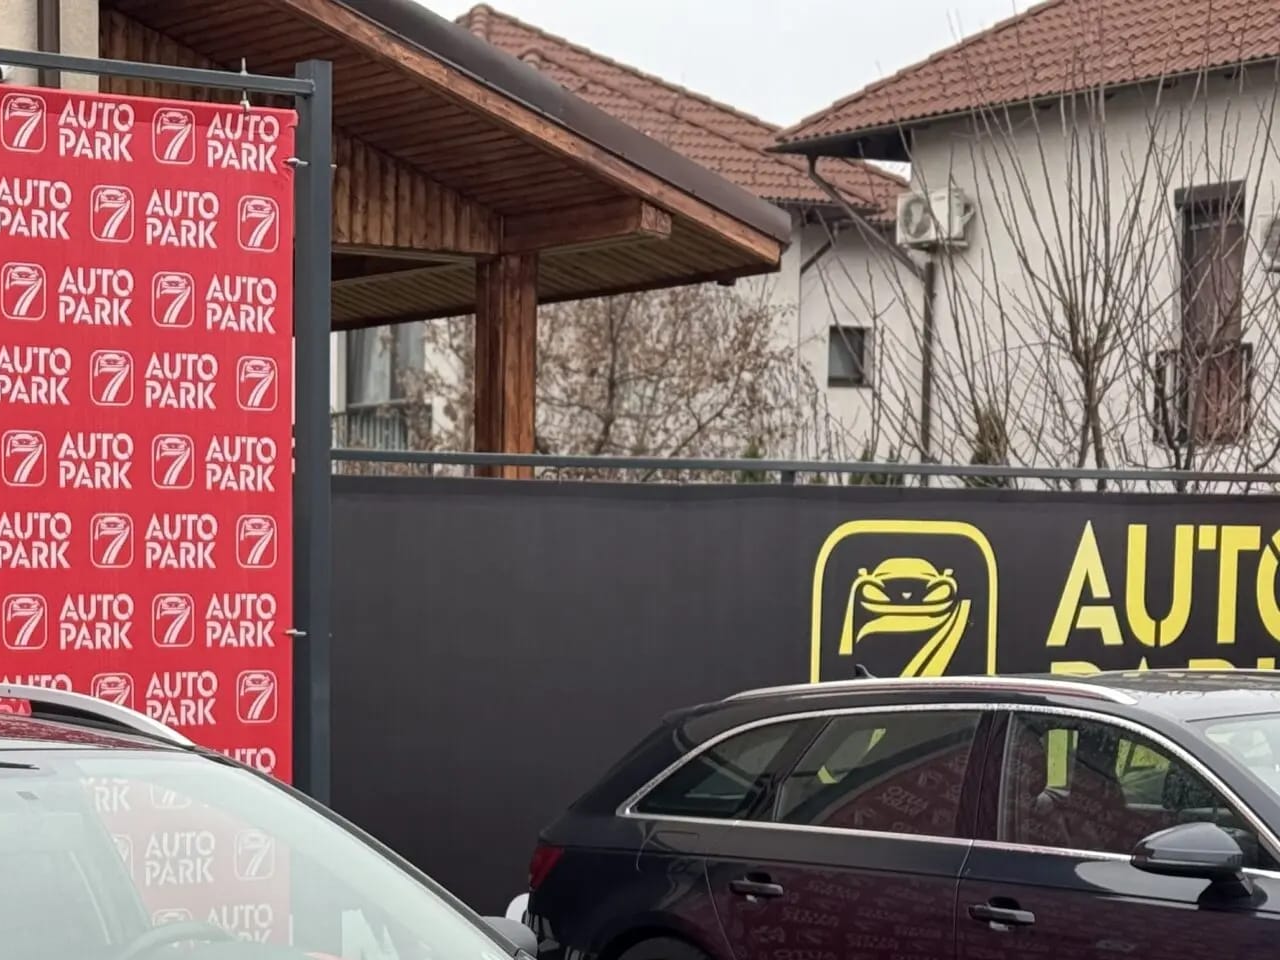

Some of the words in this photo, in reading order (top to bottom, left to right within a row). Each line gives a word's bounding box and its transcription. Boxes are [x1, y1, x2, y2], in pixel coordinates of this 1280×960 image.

[58, 100, 135, 133] AUTO
[206, 113, 281, 143] AUTO
[58, 127, 133, 162] PARK
[207, 139, 278, 174] PARK
[145, 189, 220, 220] AUTO
[145, 216, 218, 249] PARK
[57, 266, 134, 298] AUTO
[205, 274, 277, 306] AUTO
[58, 294, 132, 327] PARK
[206, 301, 276, 335] PARK
[144, 352, 219, 382] AUTO
[145, 379, 217, 410] PARK
[57, 431, 134, 461] AUTO
[204, 435, 277, 465] AUTO
[59, 459, 133, 490] PARK
[205, 462, 275, 492] PARK
[144, 513, 218, 541] AUTO
[145, 539, 216, 569] PARK
[59, 593, 134, 622] AUTO
[205, 592, 277, 621] AUTO
[59, 621, 133, 650] PARK
[206, 620, 275, 648] PARK
[145, 670, 218, 699] AUTO
[145, 698, 216, 726] PARK
[144, 830, 216, 859] AUTO
[144, 857, 215, 887] PARK
